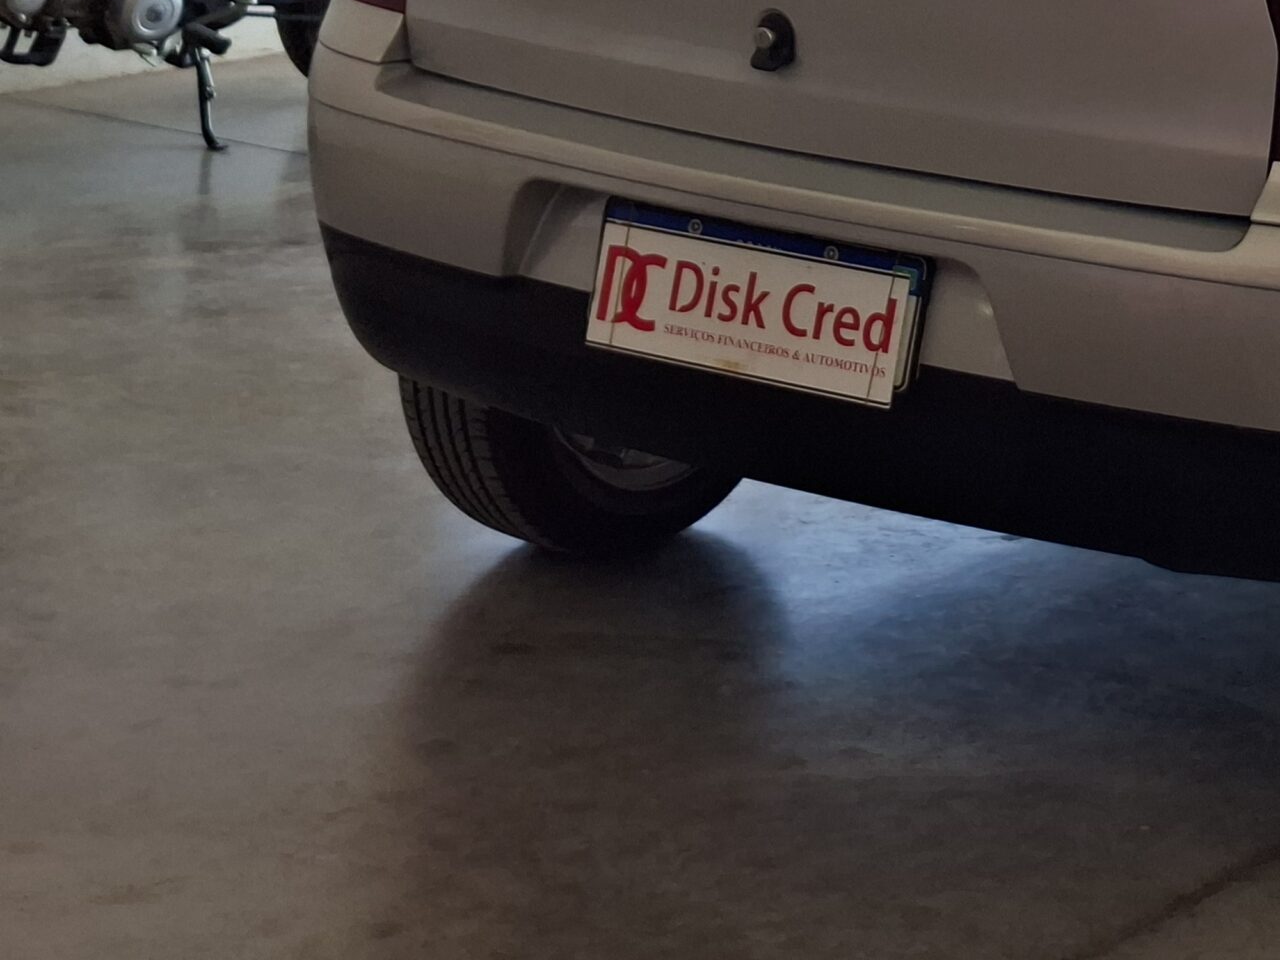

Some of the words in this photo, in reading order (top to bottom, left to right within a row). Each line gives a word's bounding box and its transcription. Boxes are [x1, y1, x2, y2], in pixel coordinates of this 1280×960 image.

[668, 260, 770, 329] Disk
[782, 284, 898, 354] Cred
[802, 352, 887, 378] AUTOMOTIVOS
